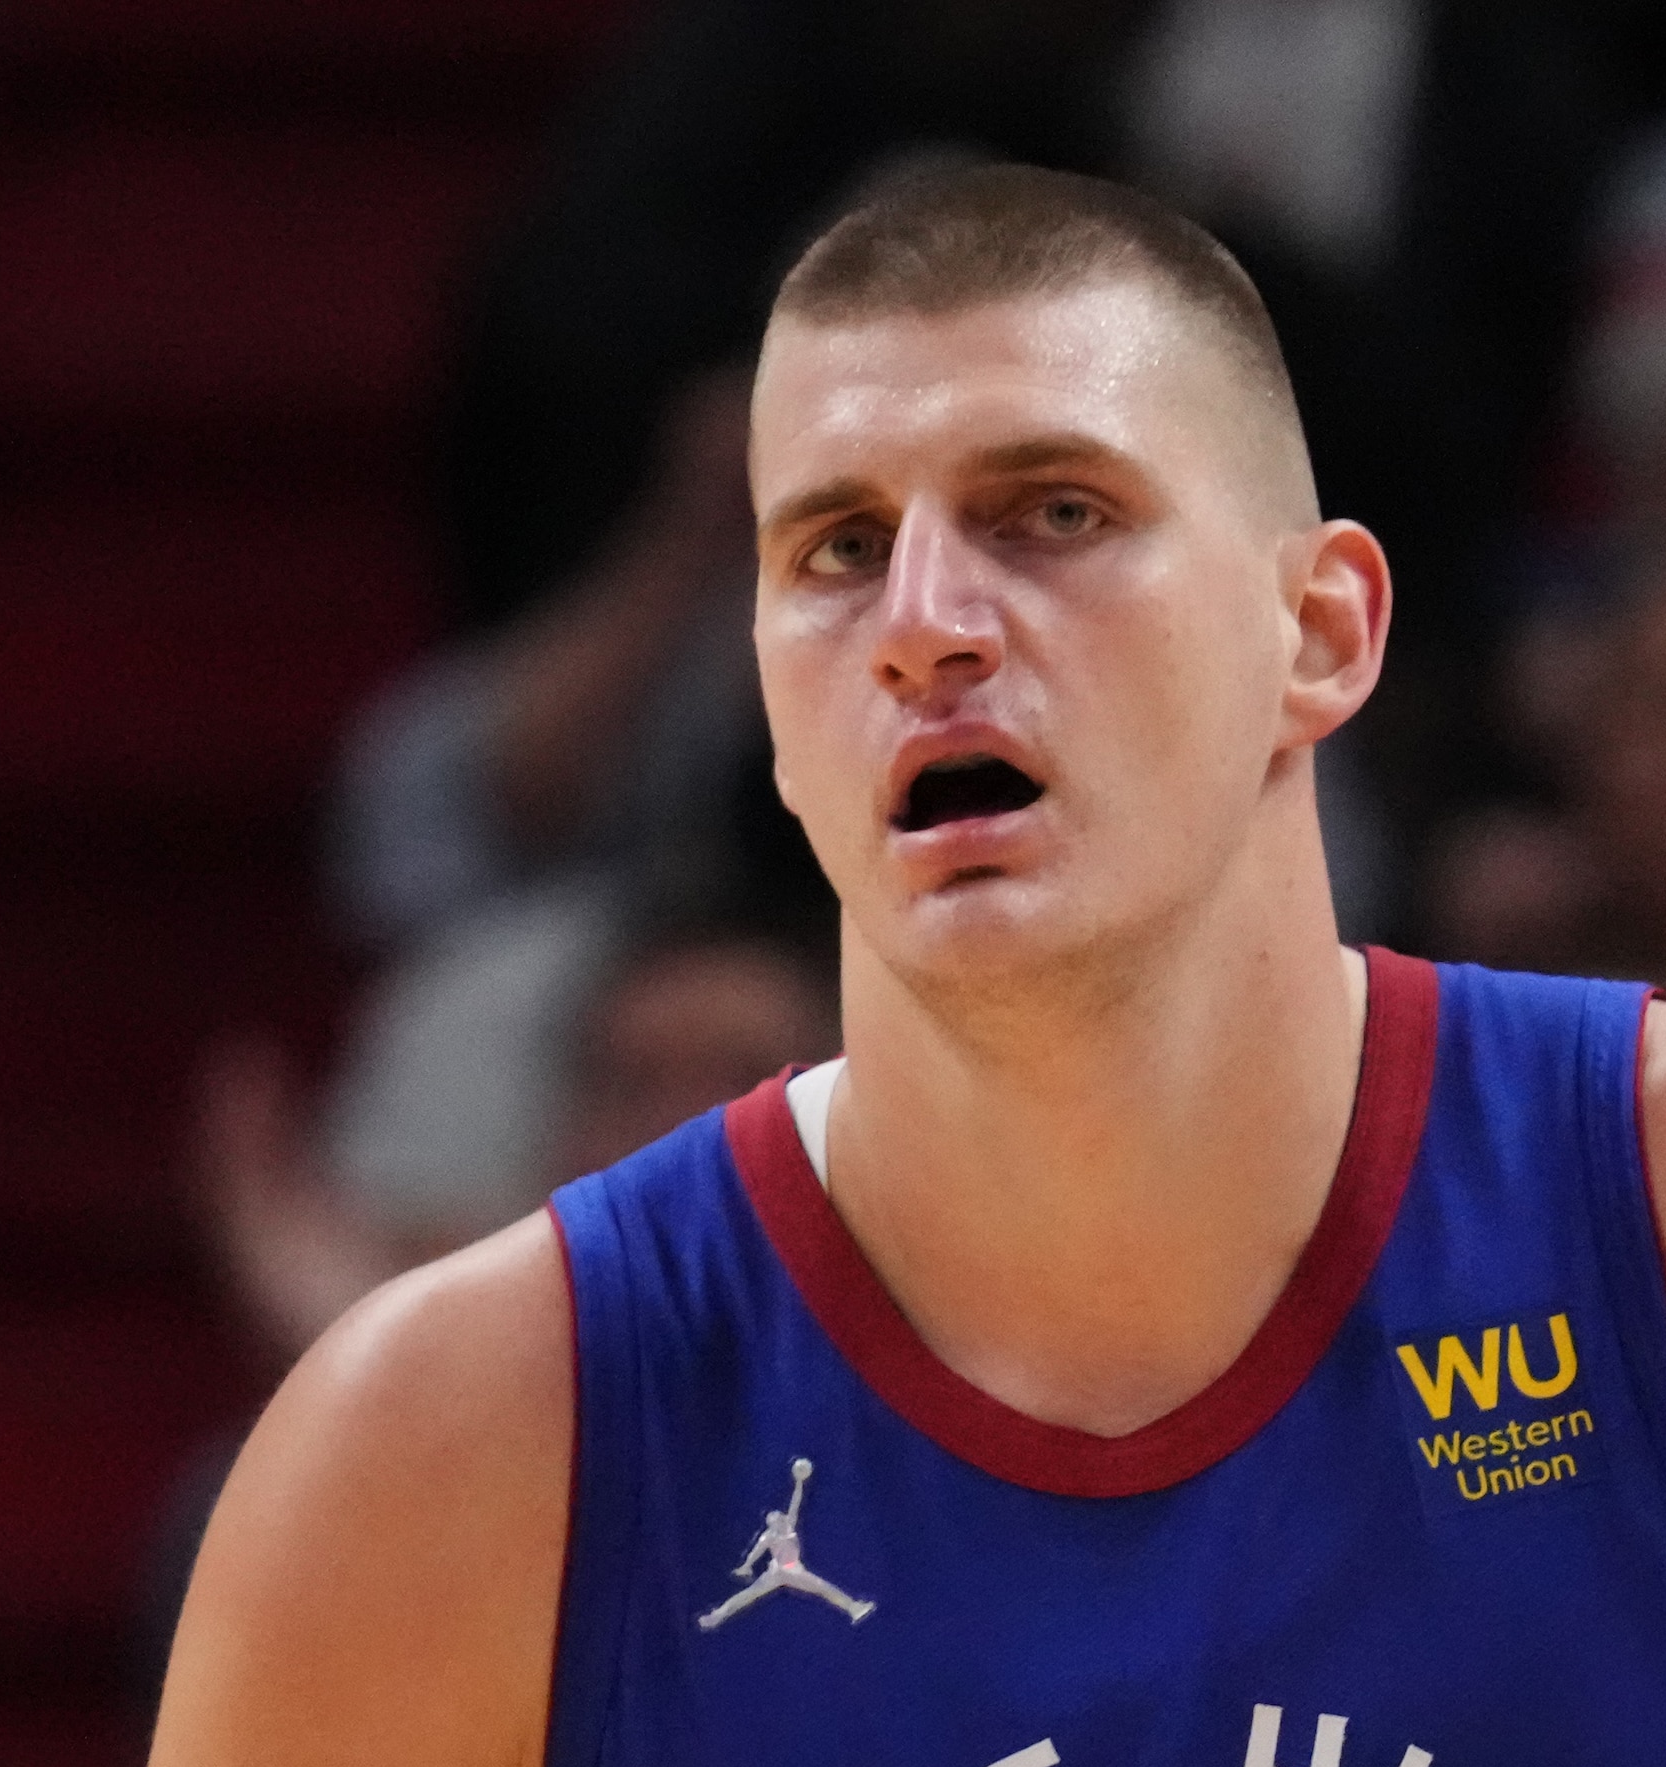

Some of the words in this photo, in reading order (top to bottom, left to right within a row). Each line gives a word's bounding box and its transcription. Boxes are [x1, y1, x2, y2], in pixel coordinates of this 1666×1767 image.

[1395, 1312, 1578, 1421] WU
[1417, 1408, 1594, 1469] Western
[1455, 1453, 1578, 1501] Union
